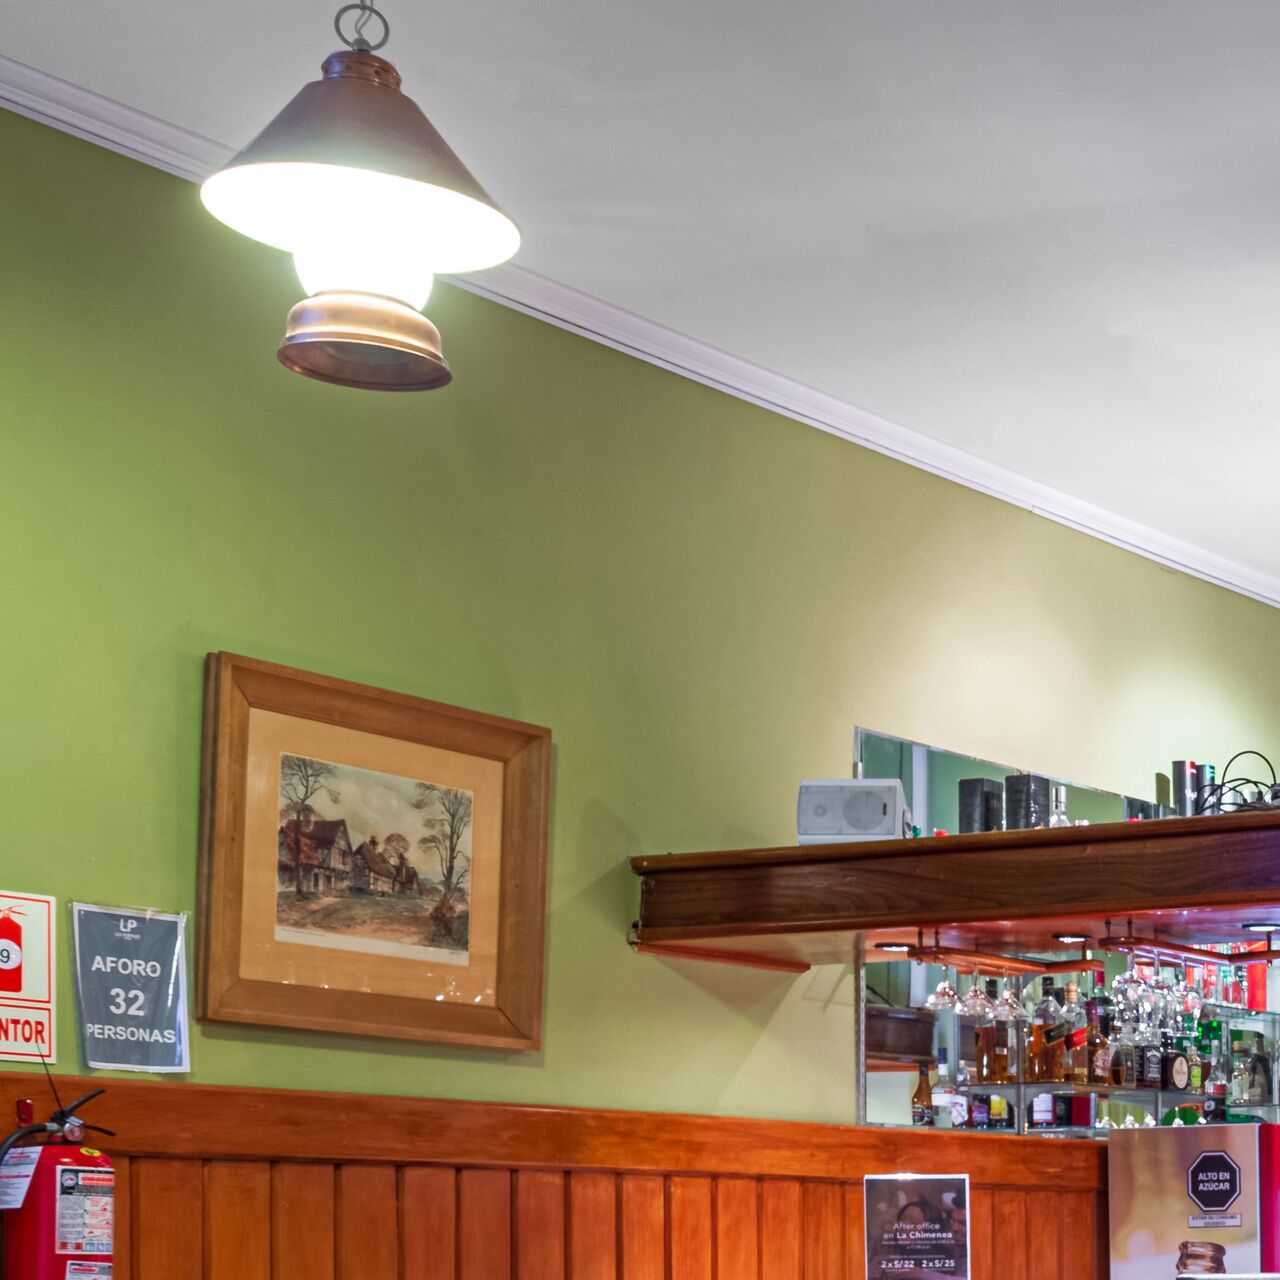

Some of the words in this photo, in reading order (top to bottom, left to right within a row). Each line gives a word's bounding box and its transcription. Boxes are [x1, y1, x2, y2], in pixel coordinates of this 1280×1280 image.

[120, 919, 138, 933] LP
[92, 955, 161, 978] AFORO
[109, 988, 145, 1017] 32
[87, 1023, 176, 1043] PERSONAS
[1198, 1172, 1217, 1180] ALTO
[1219, 1172, 1230, 1180] EN
[1199, 1181, 1230, 1190] AZÚCAR
[893, 1222, 914, 1230] After
[916, 1222, 940, 1230] office
[909, 1231, 953, 1239] Chimenea
